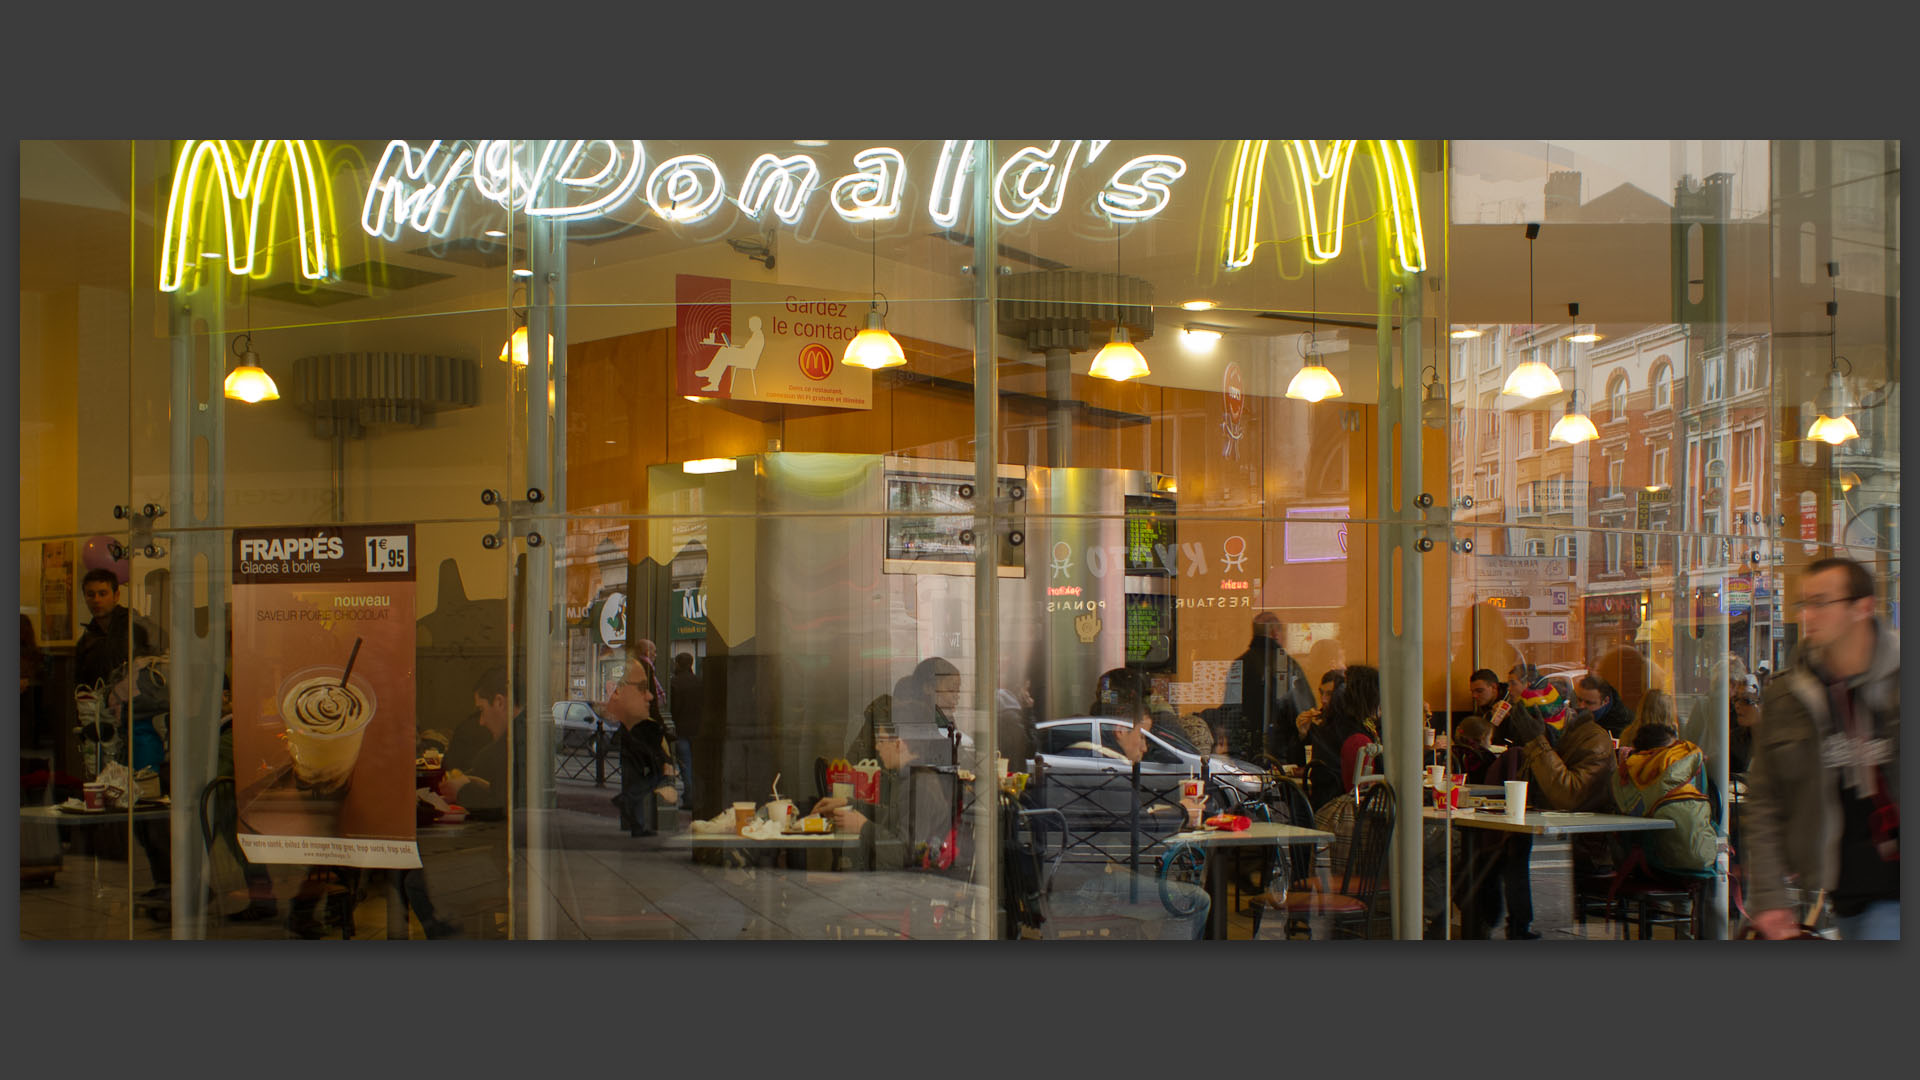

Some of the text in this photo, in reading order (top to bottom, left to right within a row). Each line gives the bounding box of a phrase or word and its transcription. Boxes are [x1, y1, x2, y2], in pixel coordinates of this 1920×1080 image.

[785, 295, 848, 318] Gardez
[772, 316, 860, 341] le contact
[240, 532, 344, 561] FRAPPÉS
[240, 560, 321, 575] Glaces à boire
[334, 595, 391, 607] nouveau
[256, 609, 297, 622] SAVEUR
[333, 608, 390, 622] CHOCOLAT
[241, 838, 253, 848] Pour
